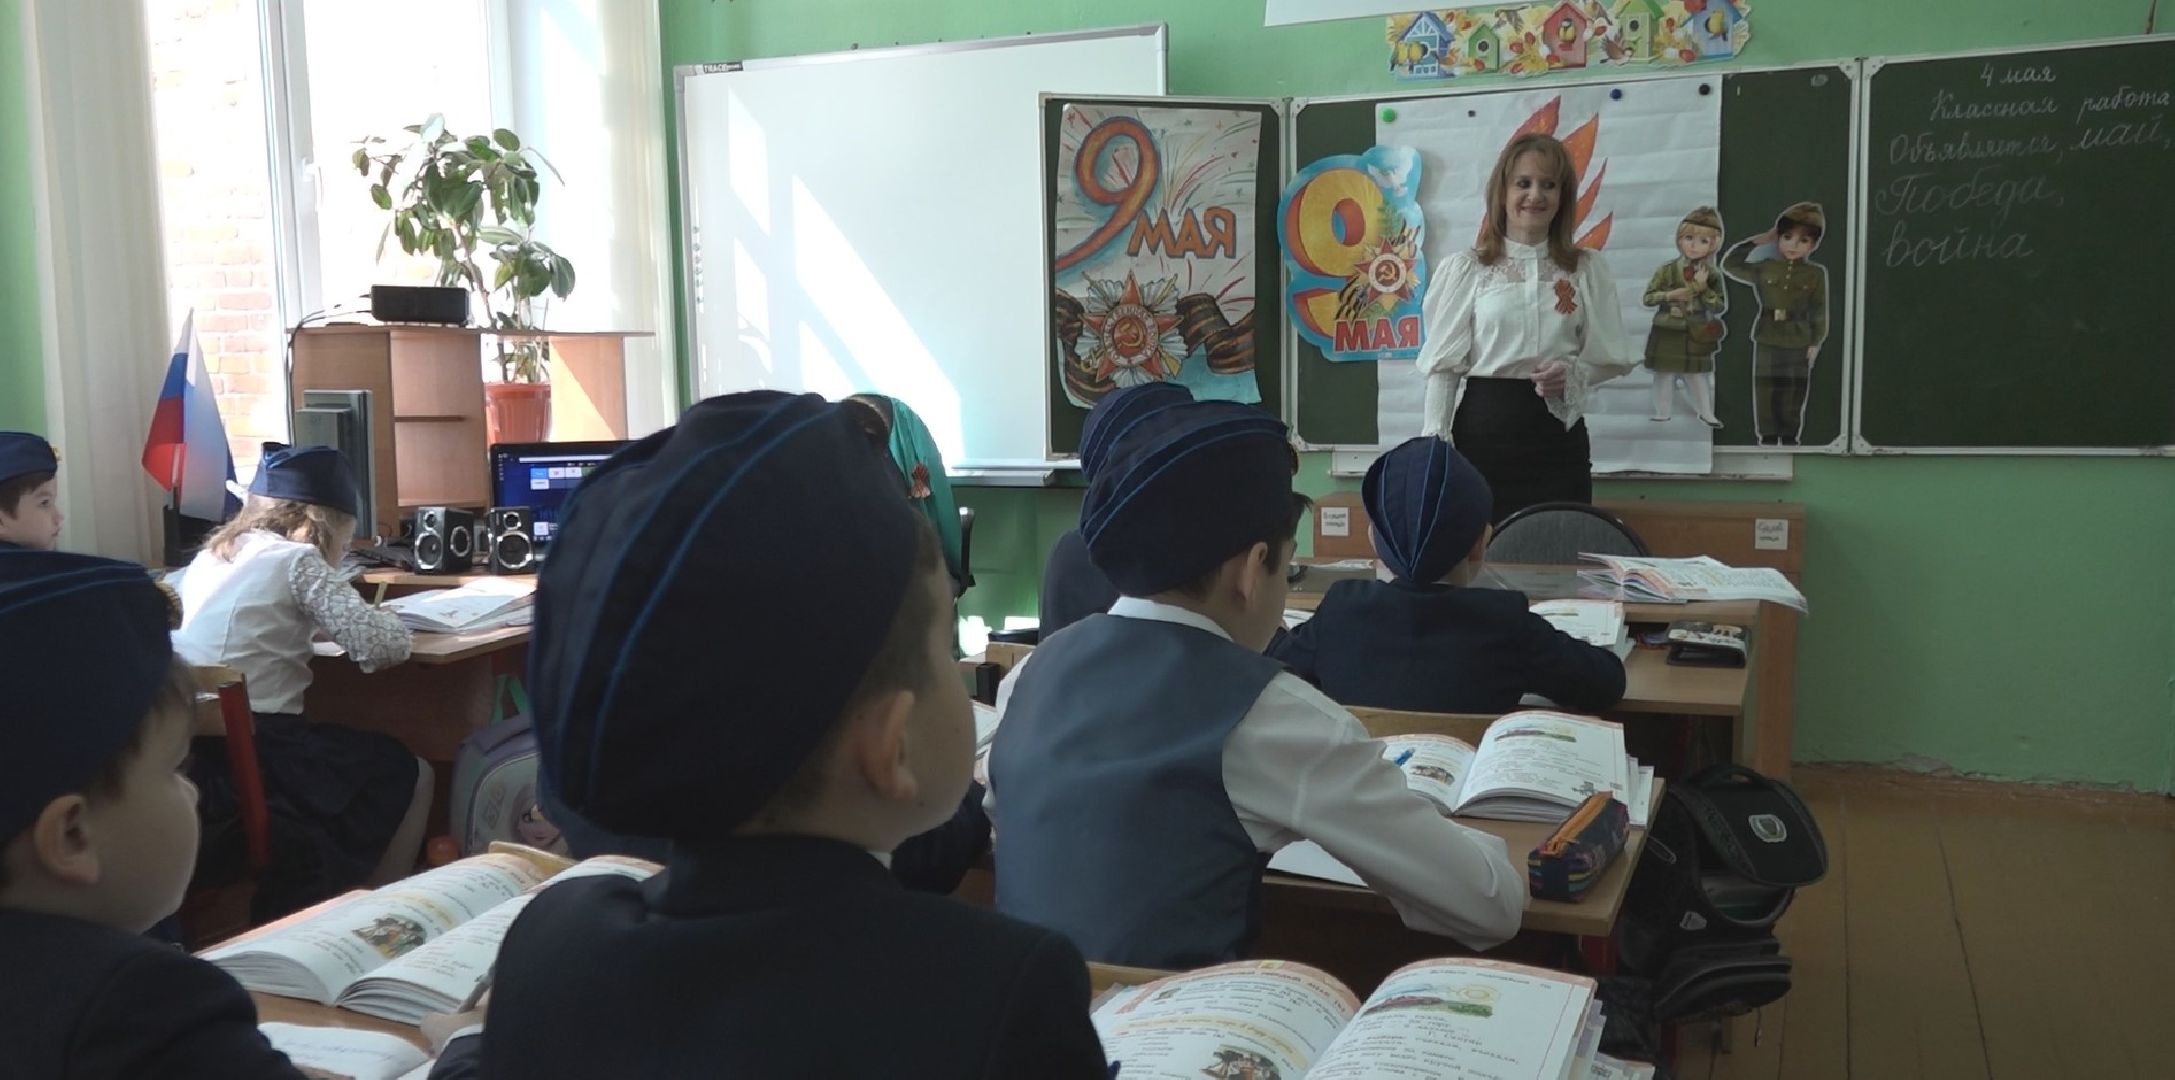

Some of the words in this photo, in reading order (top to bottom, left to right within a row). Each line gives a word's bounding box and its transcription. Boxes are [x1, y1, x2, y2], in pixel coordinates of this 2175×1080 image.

[1980, 63, 1994, 87] 4
[1999, 64, 2056, 83] мая
[1930, 89, 2059, 122] Классная
[2076, 86, 2170, 125] работа
[1054, 116, 1162, 272] 9
[1875, 165, 2065, 230] Победа,
[1127, 206, 1237, 259] МАЯ
[1284, 166, 1385, 341] 9
[1883, 220, 2034, 267] война
[1334, 317, 1420, 353] МАЯ
